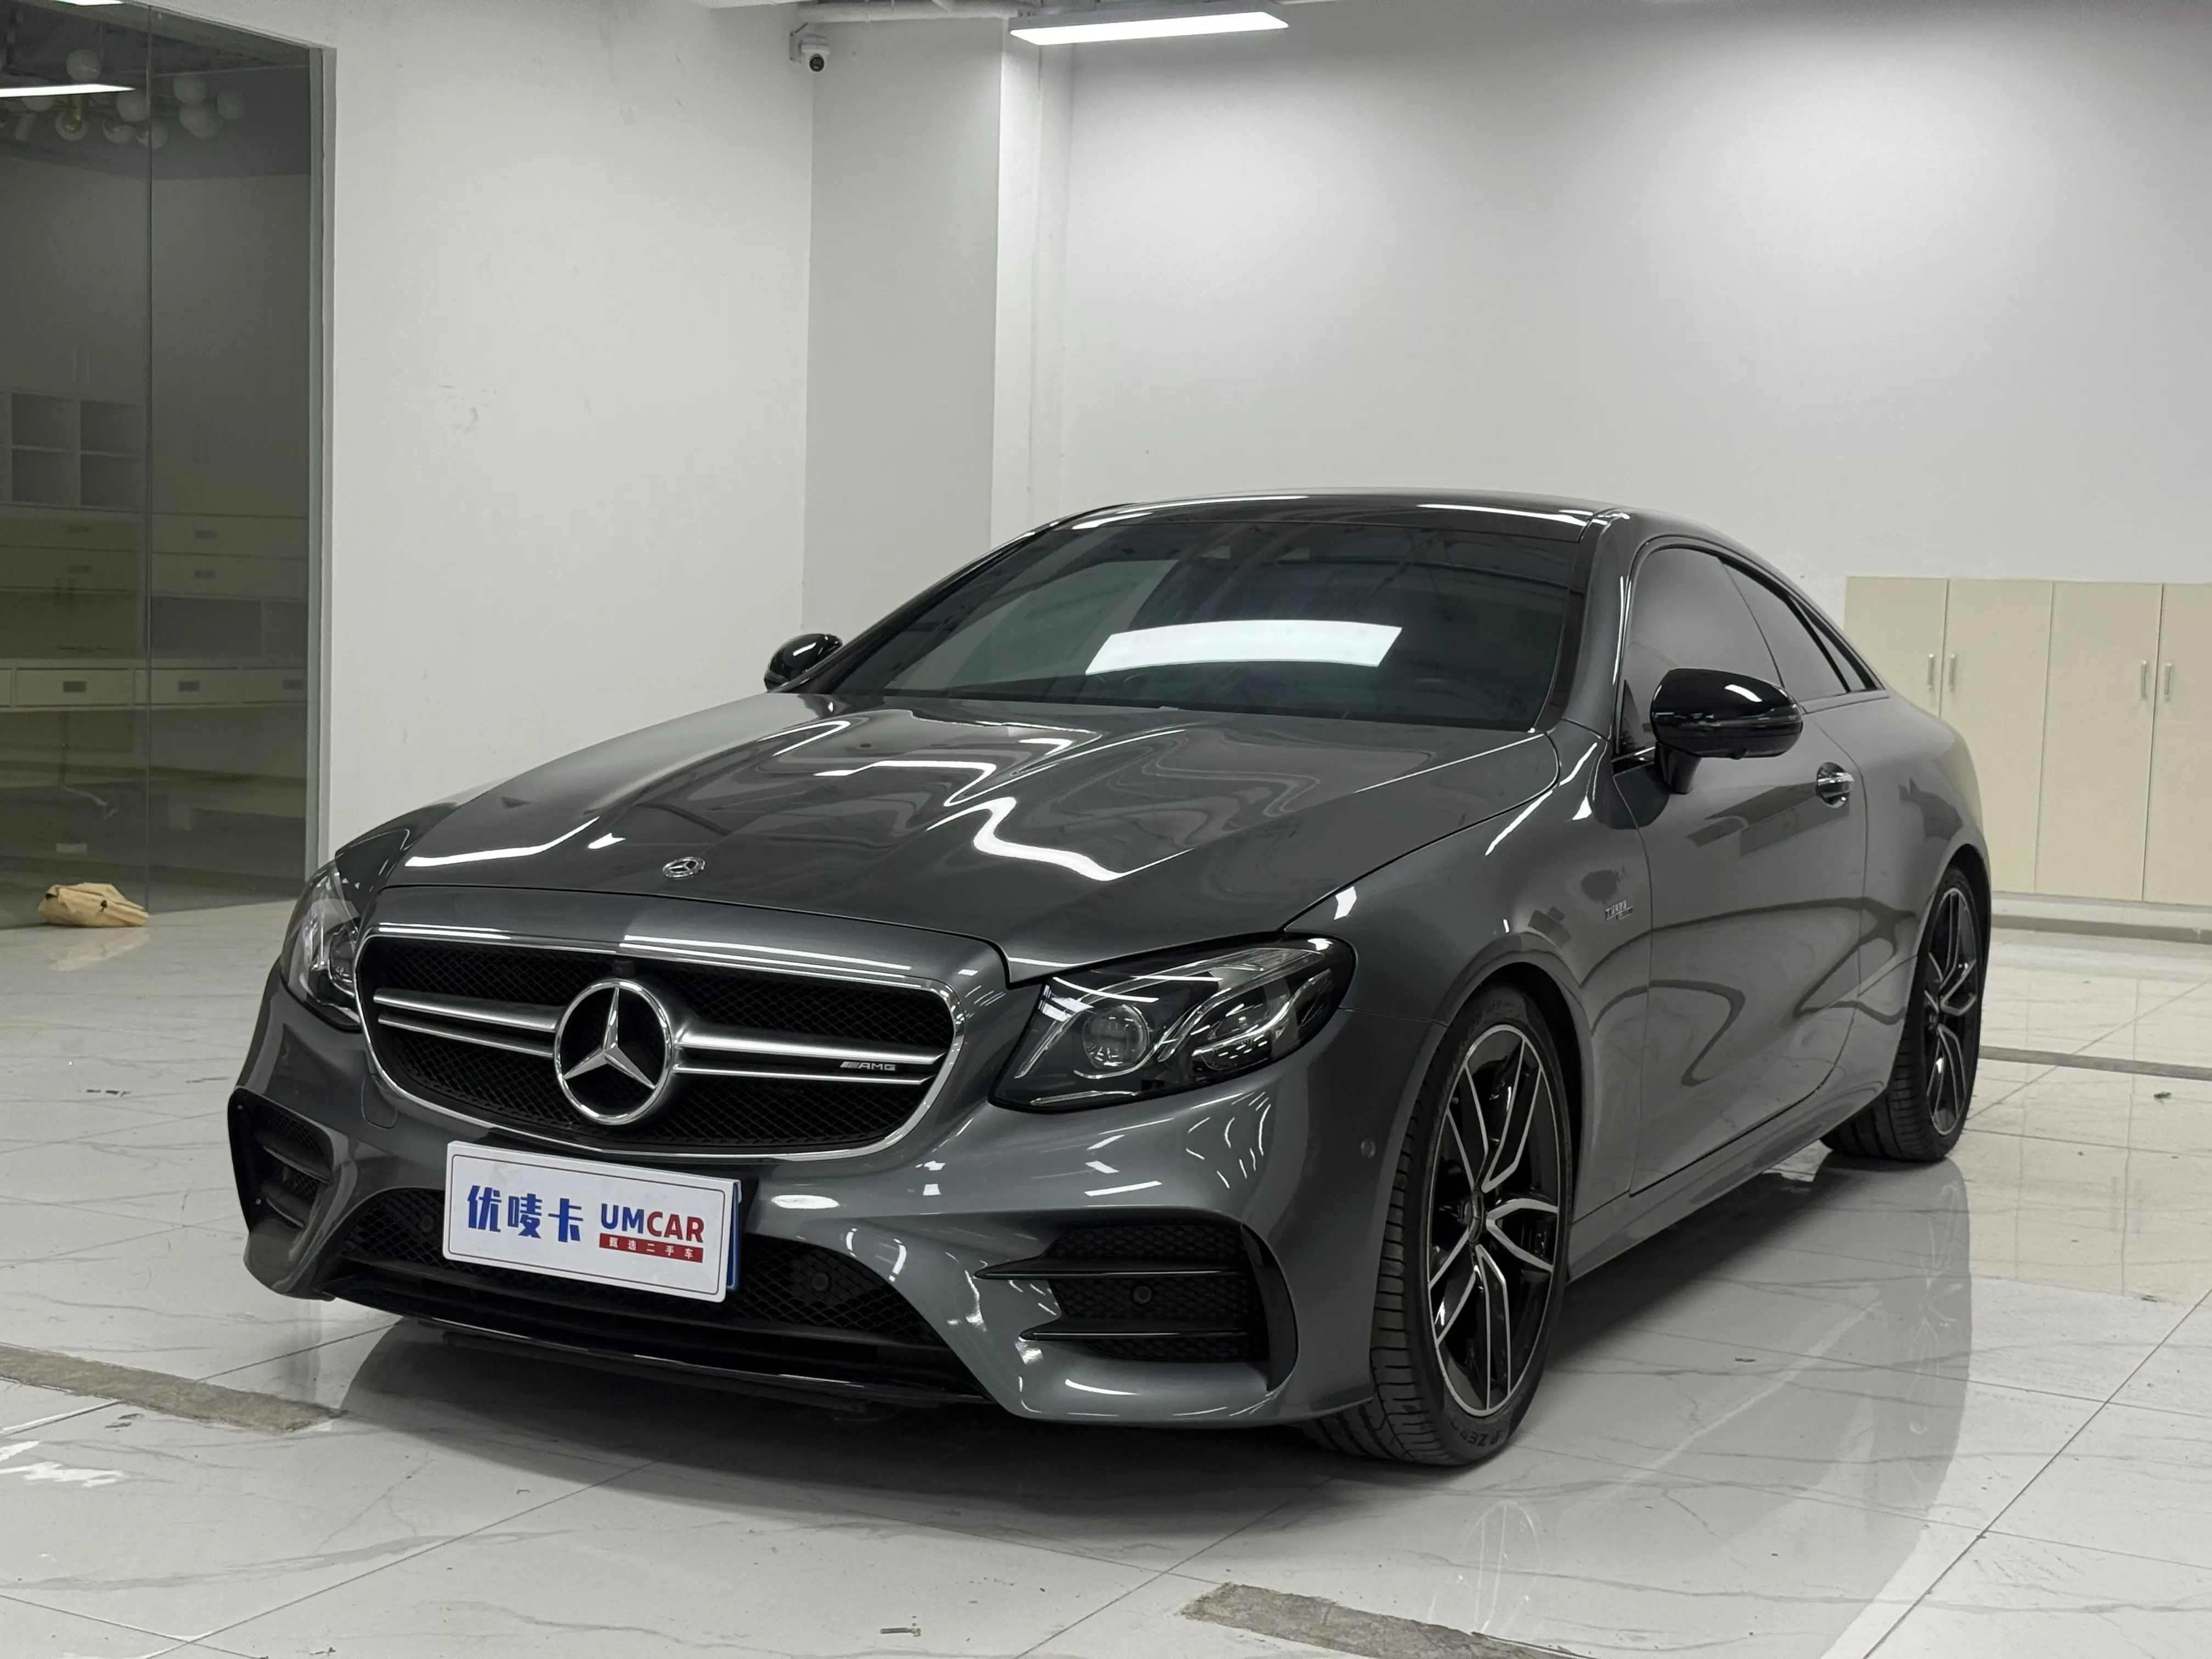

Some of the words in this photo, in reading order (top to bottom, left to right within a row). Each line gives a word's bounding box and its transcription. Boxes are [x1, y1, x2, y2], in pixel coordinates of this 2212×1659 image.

[858, 1062, 896, 1070] AMG
[467, 1185, 584, 1243] 优唛卡
[601, 1203, 704, 1243] UMCAR
